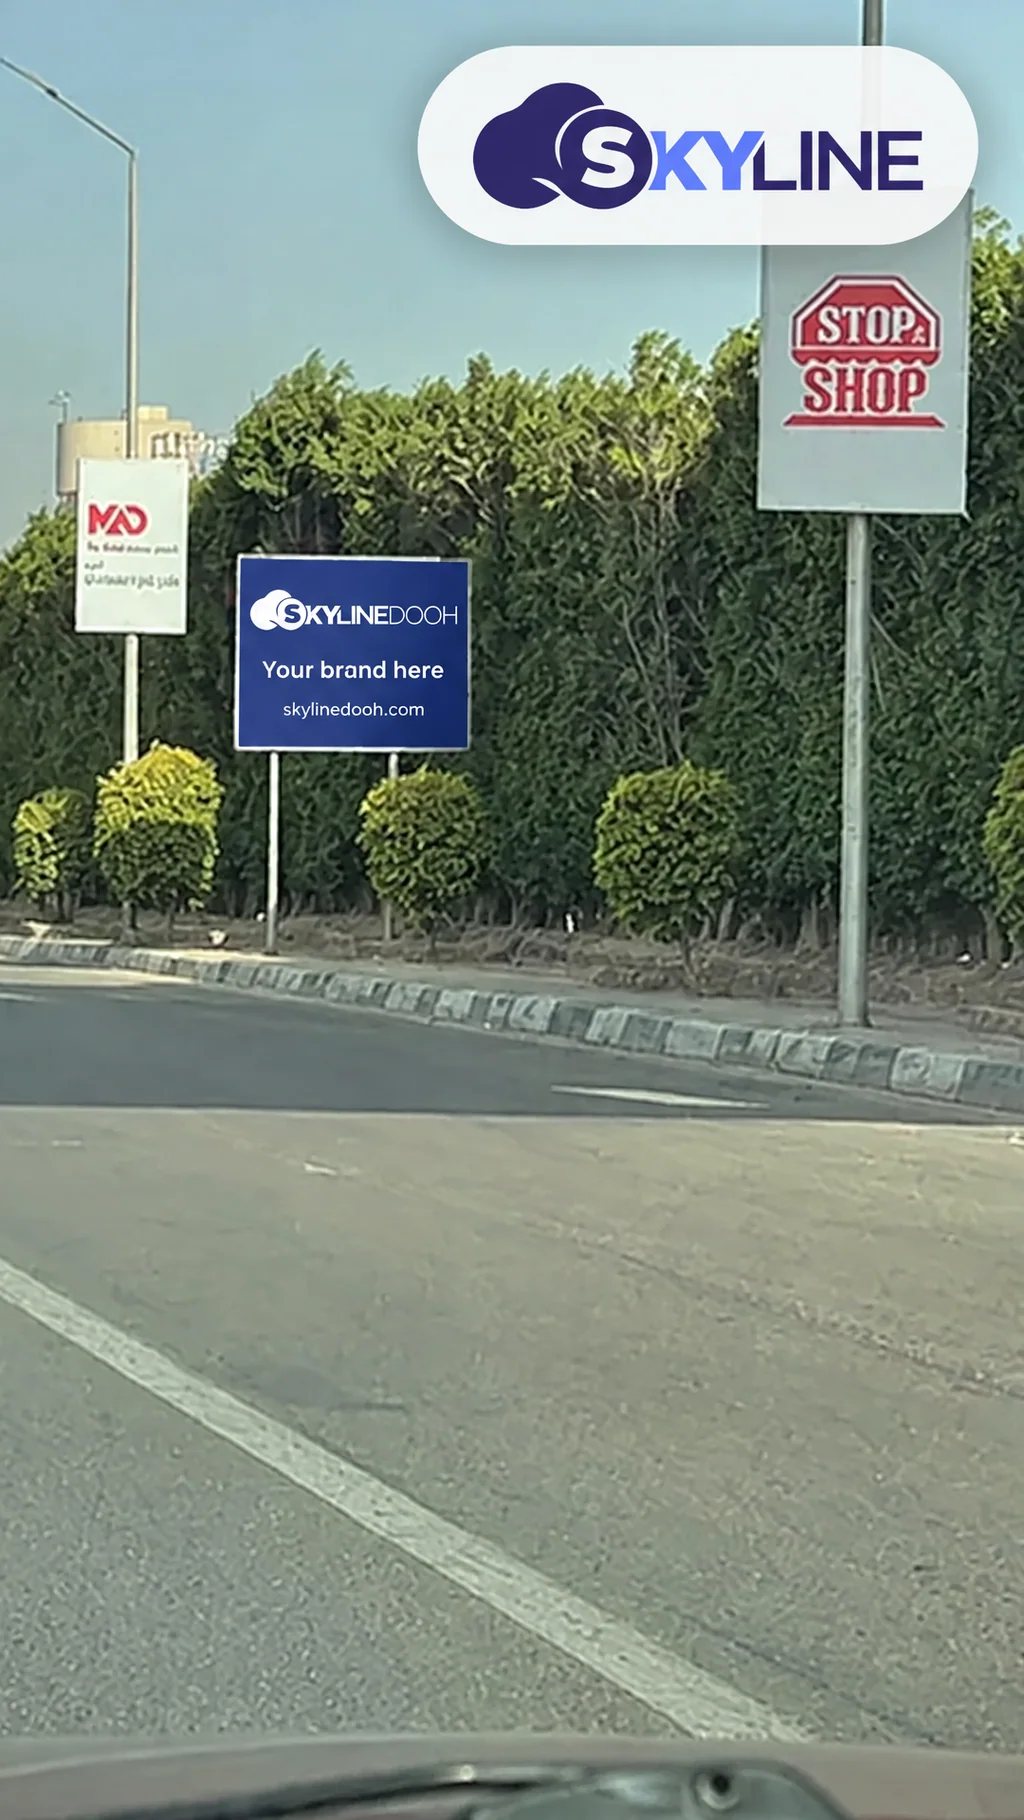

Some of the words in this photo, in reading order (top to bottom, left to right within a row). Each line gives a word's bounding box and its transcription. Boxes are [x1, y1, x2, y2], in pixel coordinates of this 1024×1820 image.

[816, 306, 915, 345] STOP
[804, 365, 927, 415] SHOP
[284, 604, 458, 625] SKYLINEDOOH
[262, 660, 314, 679] Your
[321, 660, 387, 679] brand
[394, 660, 445, 679] here
[283, 702, 424, 719] skylinedooh.com
